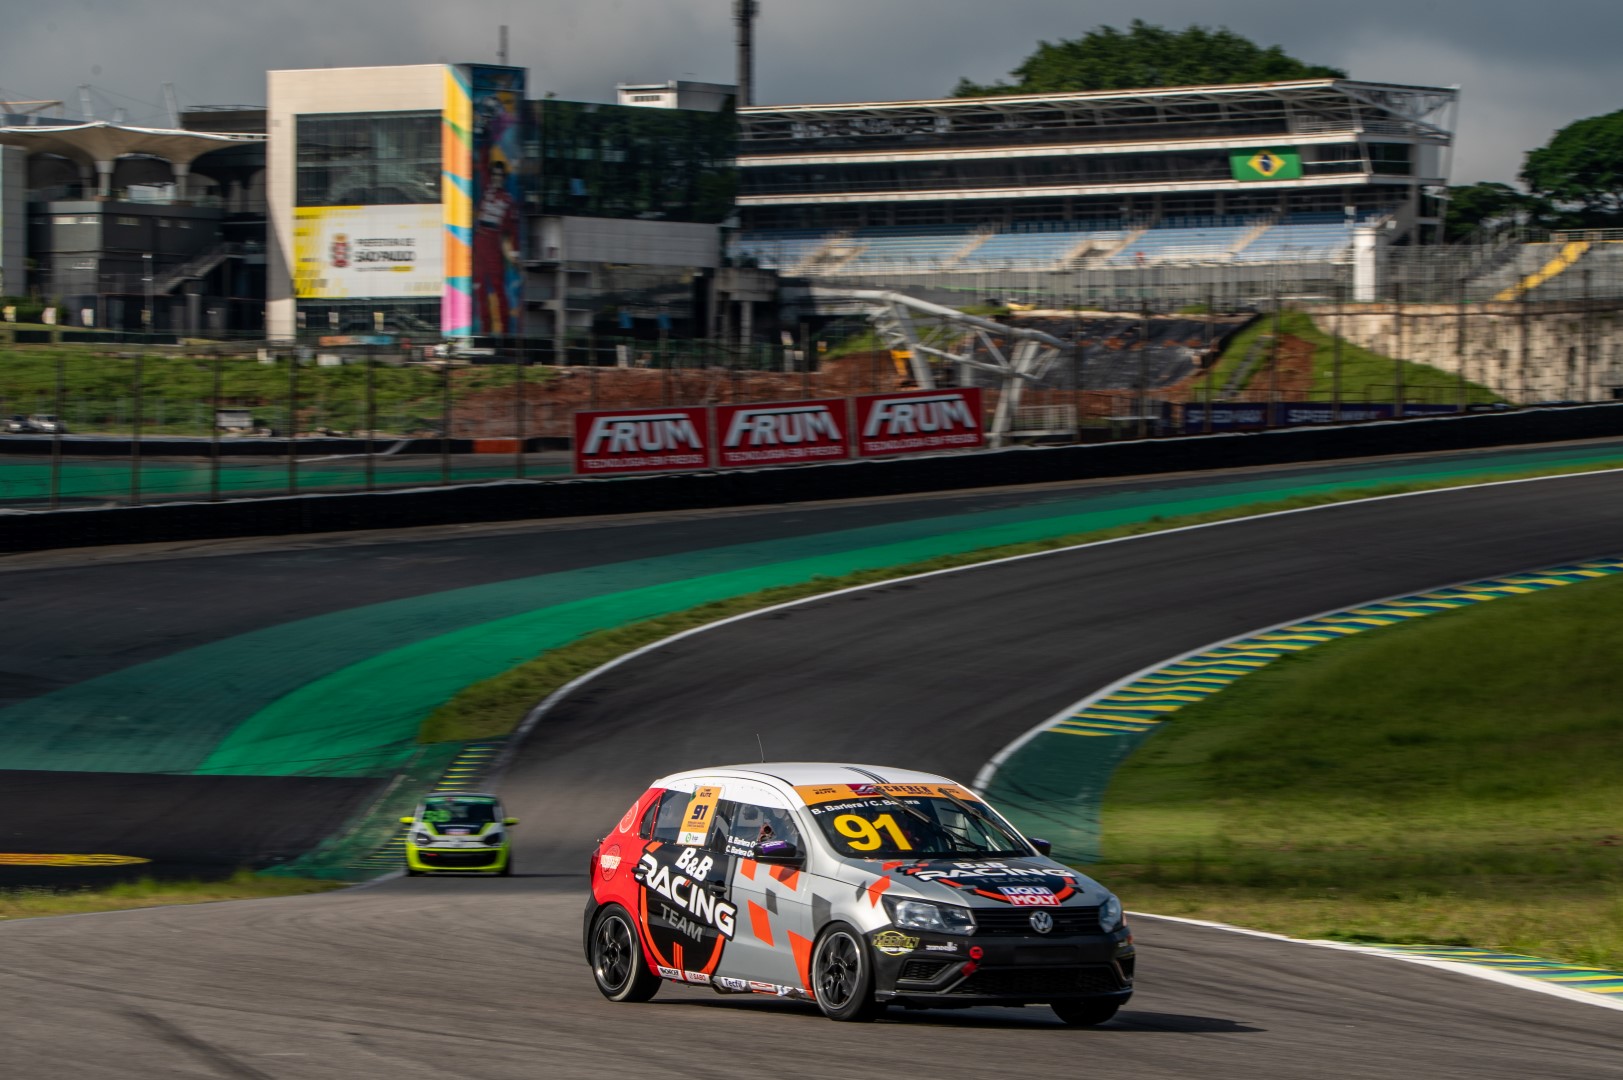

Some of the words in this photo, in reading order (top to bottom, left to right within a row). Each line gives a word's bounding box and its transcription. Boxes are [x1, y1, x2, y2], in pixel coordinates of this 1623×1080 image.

[582, 412, 703, 454] FRUM
[723, 405, 843, 447] FRUM
[862, 393, 978, 438] FRUM
[690, 804, 708, 820] 91
[833, 813, 913, 851] 91
[674, 847, 714, 882] B&B
[915, 868, 1077, 881] RACING
[634, 852, 736, 938] RACING
[1004, 886, 1049, 895] LIQUI
[1011, 895, 1055, 905] MOLY
[660, 903, 703, 943] TEAM
